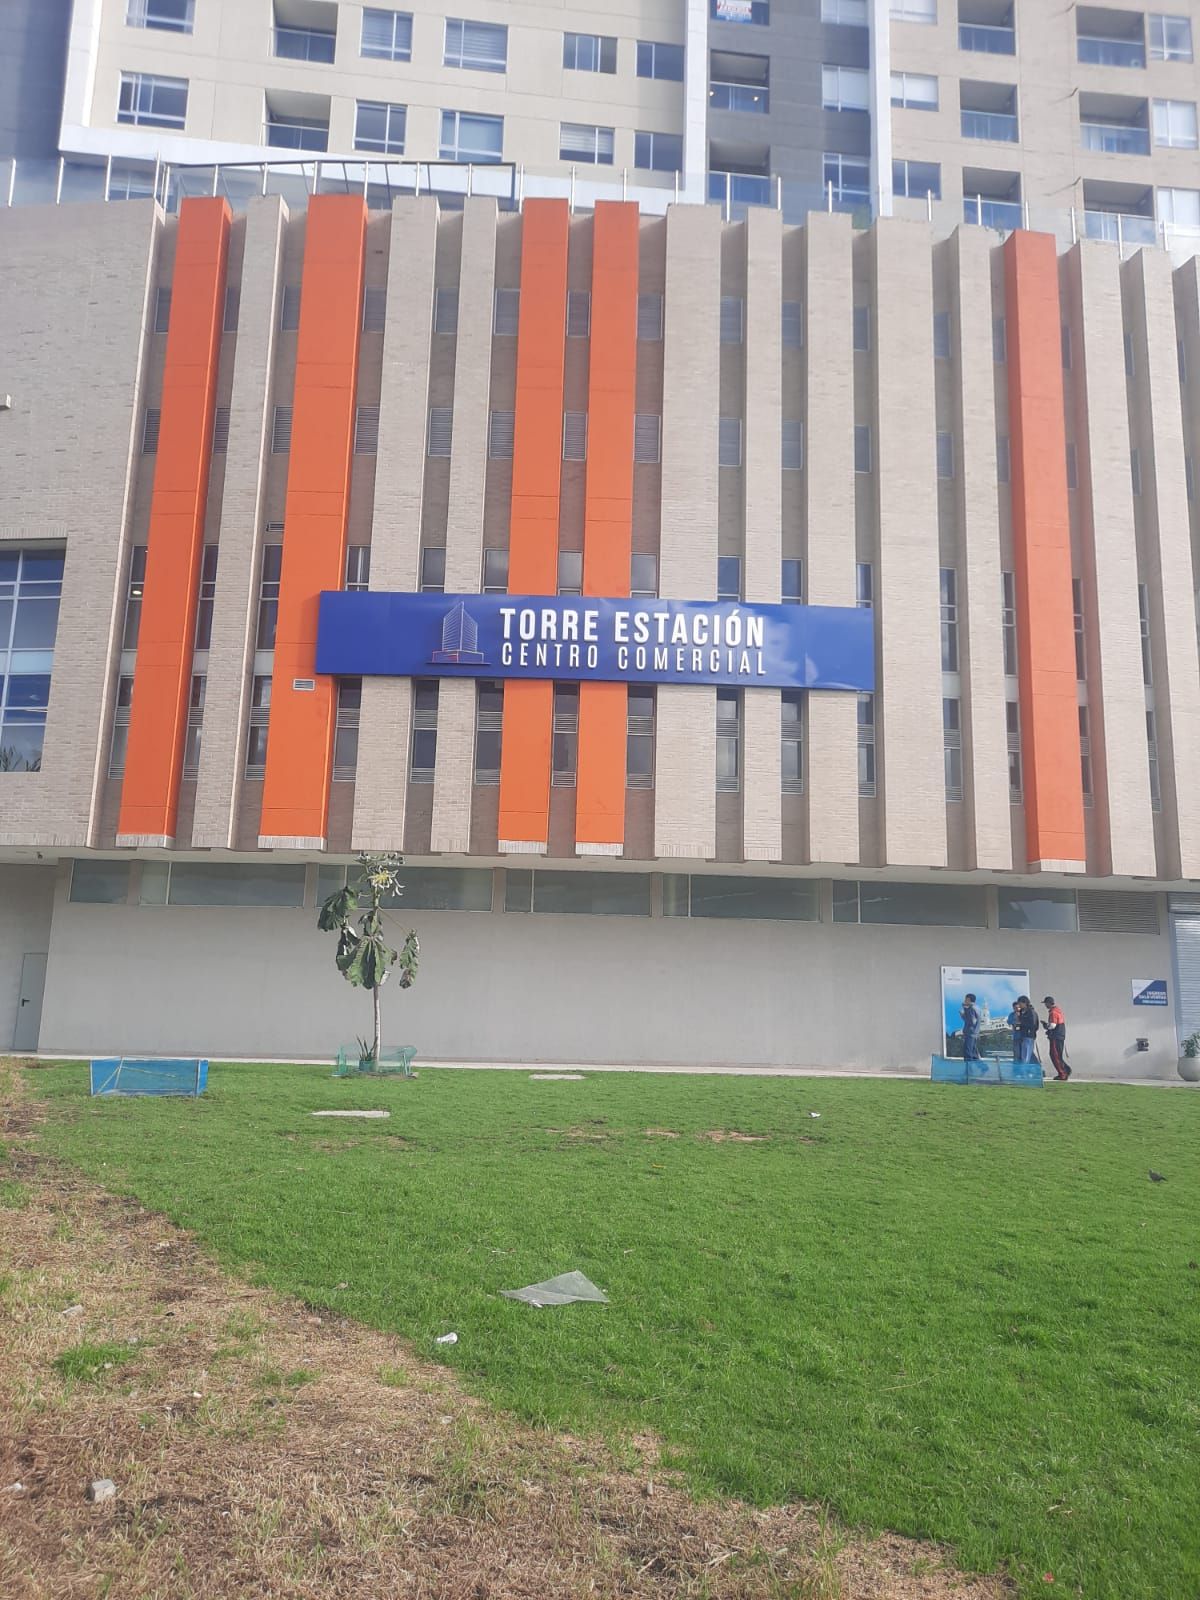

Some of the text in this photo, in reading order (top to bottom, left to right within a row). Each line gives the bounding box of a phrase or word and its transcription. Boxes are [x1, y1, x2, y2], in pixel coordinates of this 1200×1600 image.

[500, 608, 763, 647] TORRE ESTACIÓN
[502, 642, 766, 674] CENTRO COMERCIAL
